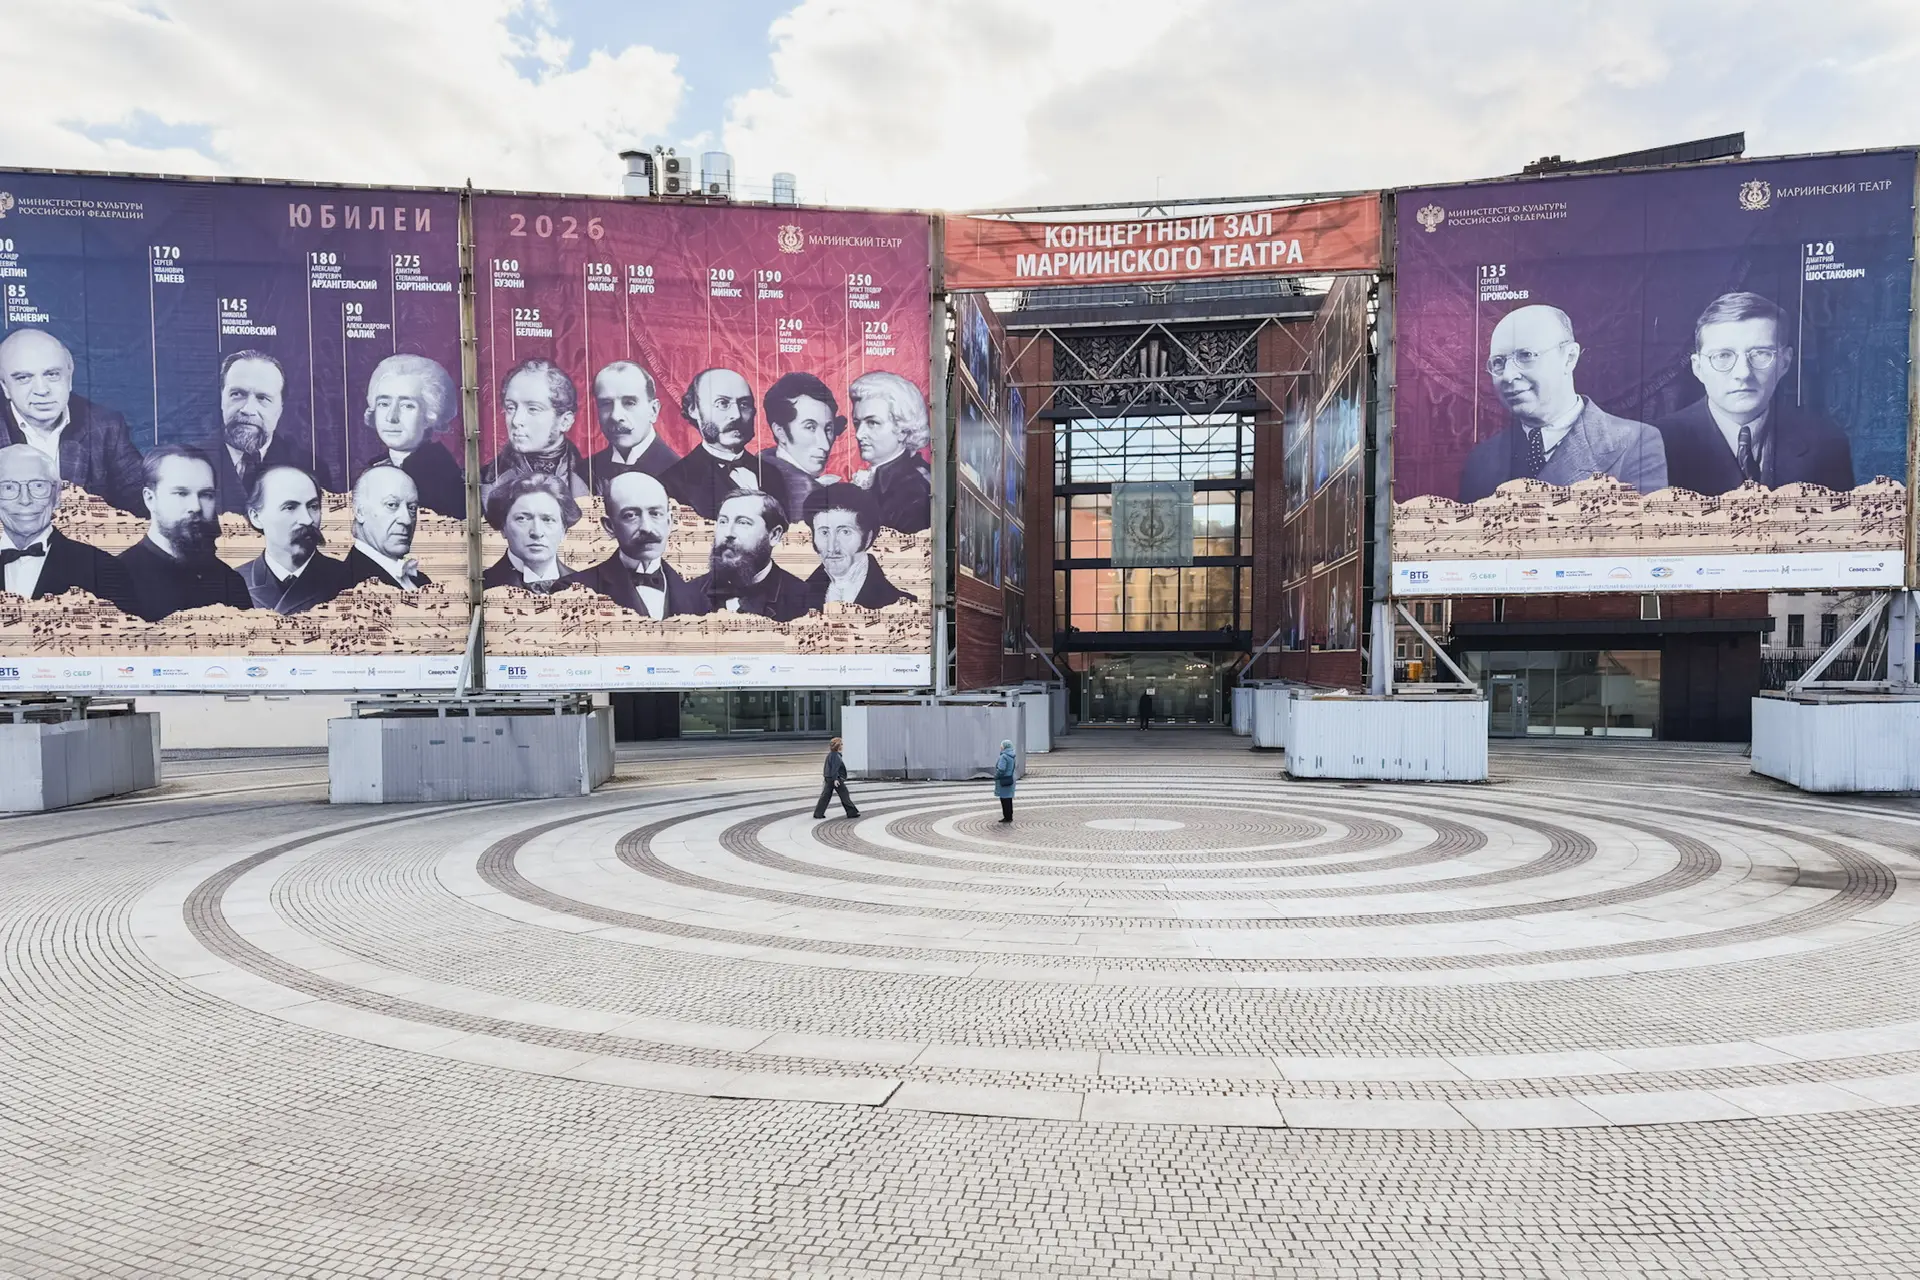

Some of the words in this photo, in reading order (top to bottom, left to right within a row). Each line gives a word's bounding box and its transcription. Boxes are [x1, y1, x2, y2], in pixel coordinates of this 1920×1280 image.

[1776, 182, 1855, 198] МАРИИНСКИЙ
[1858, 180, 1892, 192] ТЕАТР
[18, 198, 94, 208] МИНИСТЕРСТВО
[97, 201, 143, 210] КУЛЬТУРЫ
[1448, 205, 1520, 217] МИНИСТЕРСТВО
[1522, 202, 1567, 212] КУЛЬТУРЫ
[19, 206, 85, 216] РОССИЙСКОЙ
[87, 210, 144, 219] ФЕДЕРАЦИИ
[289, 203, 431, 232] ЮБИЛЕИ
[1448, 214, 1510, 226] РОССИЙСКОЙ
[1512, 211, 1567, 222] ФЕДЕРАЦИИ
[509, 213, 605, 240] 2026
[1045, 215, 1215, 248] КОНЦЕРТНЫЙ
[1224, 213, 1272, 238] ЗАЛ
[809, 235, 874, 247] МАРИИНСКИЙ
[874, 237, 902, 248] ТЕАТР
[153, 246, 180, 259] 170
[1805, 242, 1834, 256] 120
[311, 252, 337, 265] 180
[395, 255, 420, 267] 275
[1016, 246, 1201, 277] МАРИИНСКОГО
[1210, 239, 1303, 268] ТЕАТРА
[1805, 255, 1834, 264] ДМИТРИЙ
[311, 265, 341, 273] АЛЕКСАНДР
[494, 259, 519, 272] 160
[587, 263, 612, 275] 150
[628, 265, 654, 277] 180
[1481, 264, 1506, 277] 135
[154, 273, 185, 283] ТАНЕЕВ
[710, 269, 735, 281] 200
[758, 270, 782, 282] 190
[848, 274, 872, 286] 250
[1805, 268, 1865, 280] ШОСТАКОВИЧ
[311, 279, 378, 290] АРХАНГЕЛЬСКИЙ
[395, 281, 452, 292] БОРТНЯНСКИЙ
[494, 278, 525, 289] БУЗОНИ
[588, 282, 615, 292] ФАЛЬЯ
[1481, 277, 1499, 285] СЕРГЕЙ
[8, 284, 26, 297] 85
[629, 284, 655, 294] ДРИГО
[711, 288, 742, 297] МИНКУС
[758, 289, 784, 299] ДЕЛИБ
[1481, 290, 1529, 301] ПРОКОФЬЕВ
[221, 299, 248, 311] 145
[346, 303, 363, 315] 90
[849, 300, 880, 309] ГОФМАН
[9, 313, 49, 323] БАНЕВИЧ
[515, 308, 540, 321] 225
[222, 326, 277, 336] МЯСКОВСКИЙ
[779, 319, 803, 331] 240
[865, 322, 888, 333] 270
[346, 330, 376, 339] ФАЛИК
[516, 328, 553, 338] БЕЛЛИНИ
[780, 344, 803, 353] ВЕБЕР
[865, 347, 896, 357] МОЦАРТ
[1409, 571, 1429, 579] ВТБ
[1848, 565, 1881, 573] Северсталь
[508, 667, 527, 675] ВТБ
